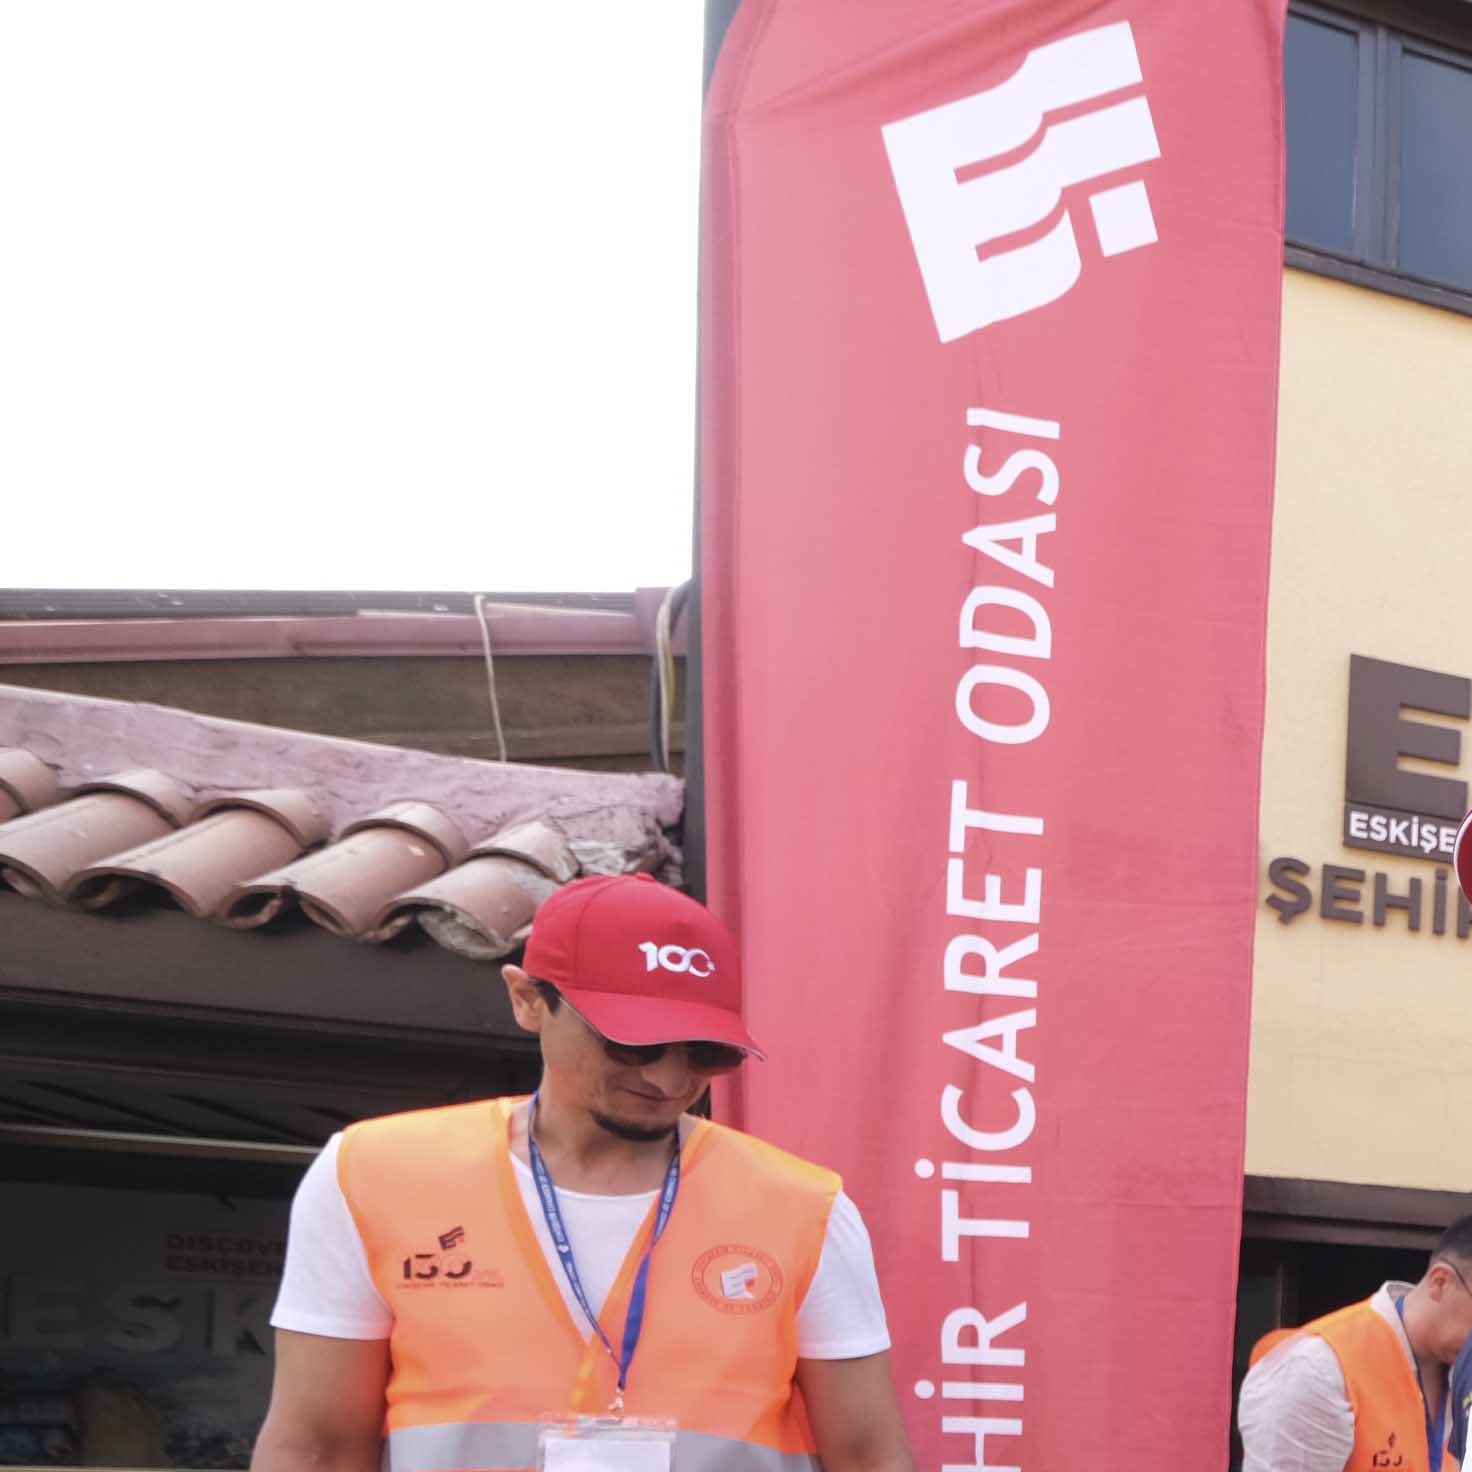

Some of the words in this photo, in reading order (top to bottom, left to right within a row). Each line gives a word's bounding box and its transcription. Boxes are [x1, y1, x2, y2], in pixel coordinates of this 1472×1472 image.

[954, 407, 1061, 745] ODASI
[1348, 810, 1457, 854] ESKİŞE
[914, 780, 1044, 1262] TİCARET
